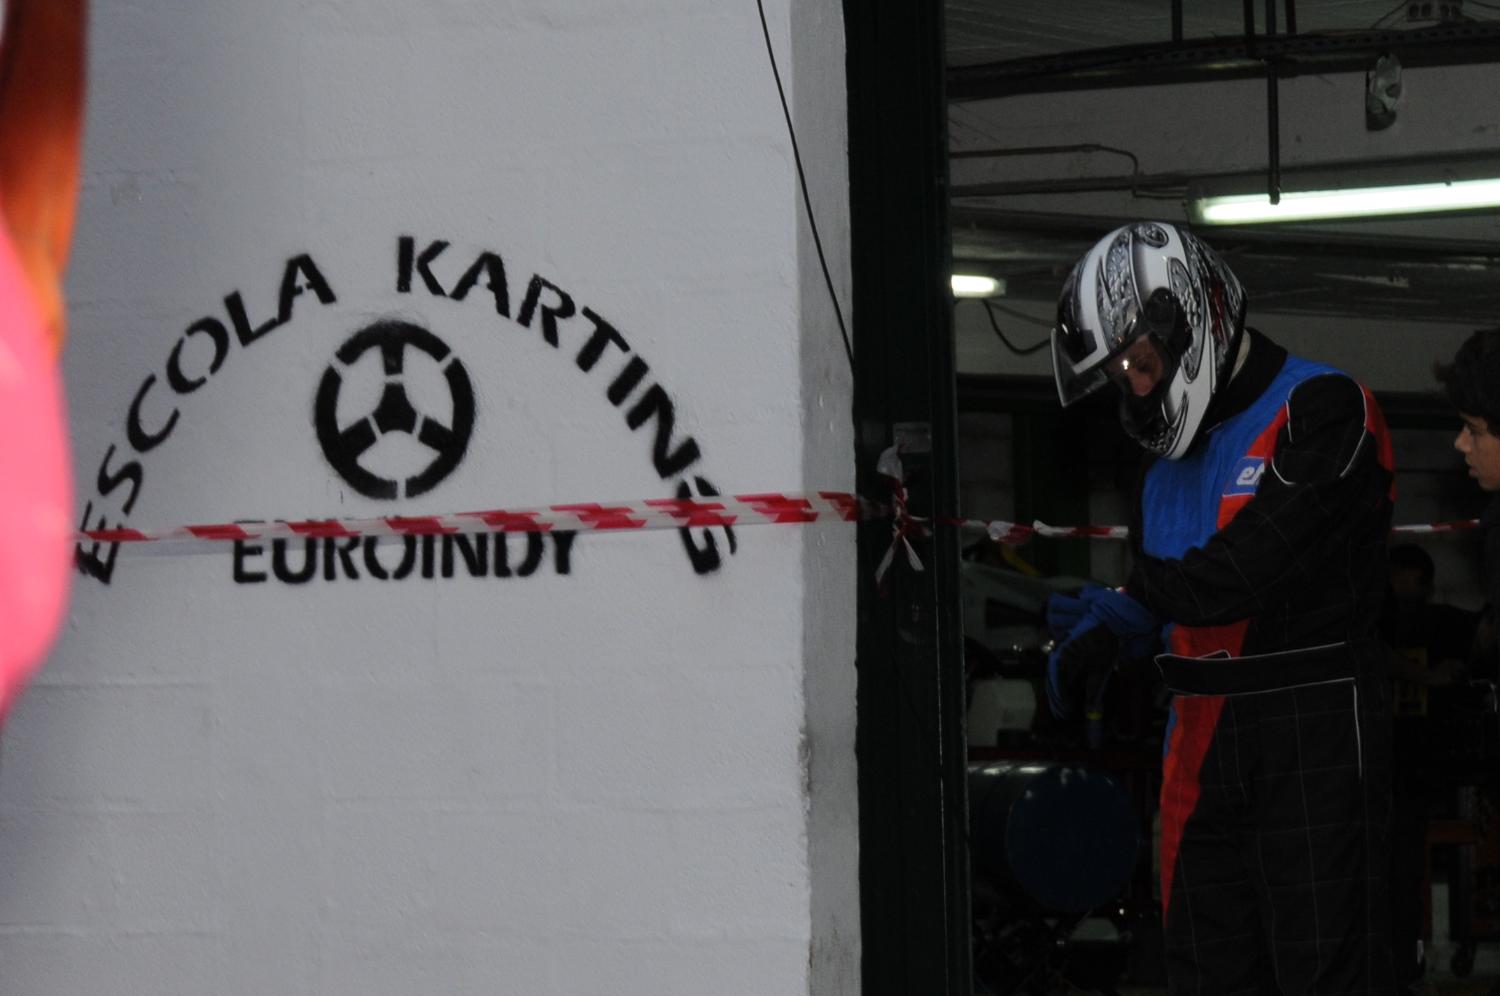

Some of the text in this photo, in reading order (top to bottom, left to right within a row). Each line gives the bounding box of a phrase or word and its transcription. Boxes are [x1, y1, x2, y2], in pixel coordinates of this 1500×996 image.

[74, 235, 738, 586] ESCOLA KARTING
[231, 514, 578, 585] EUROINDY
